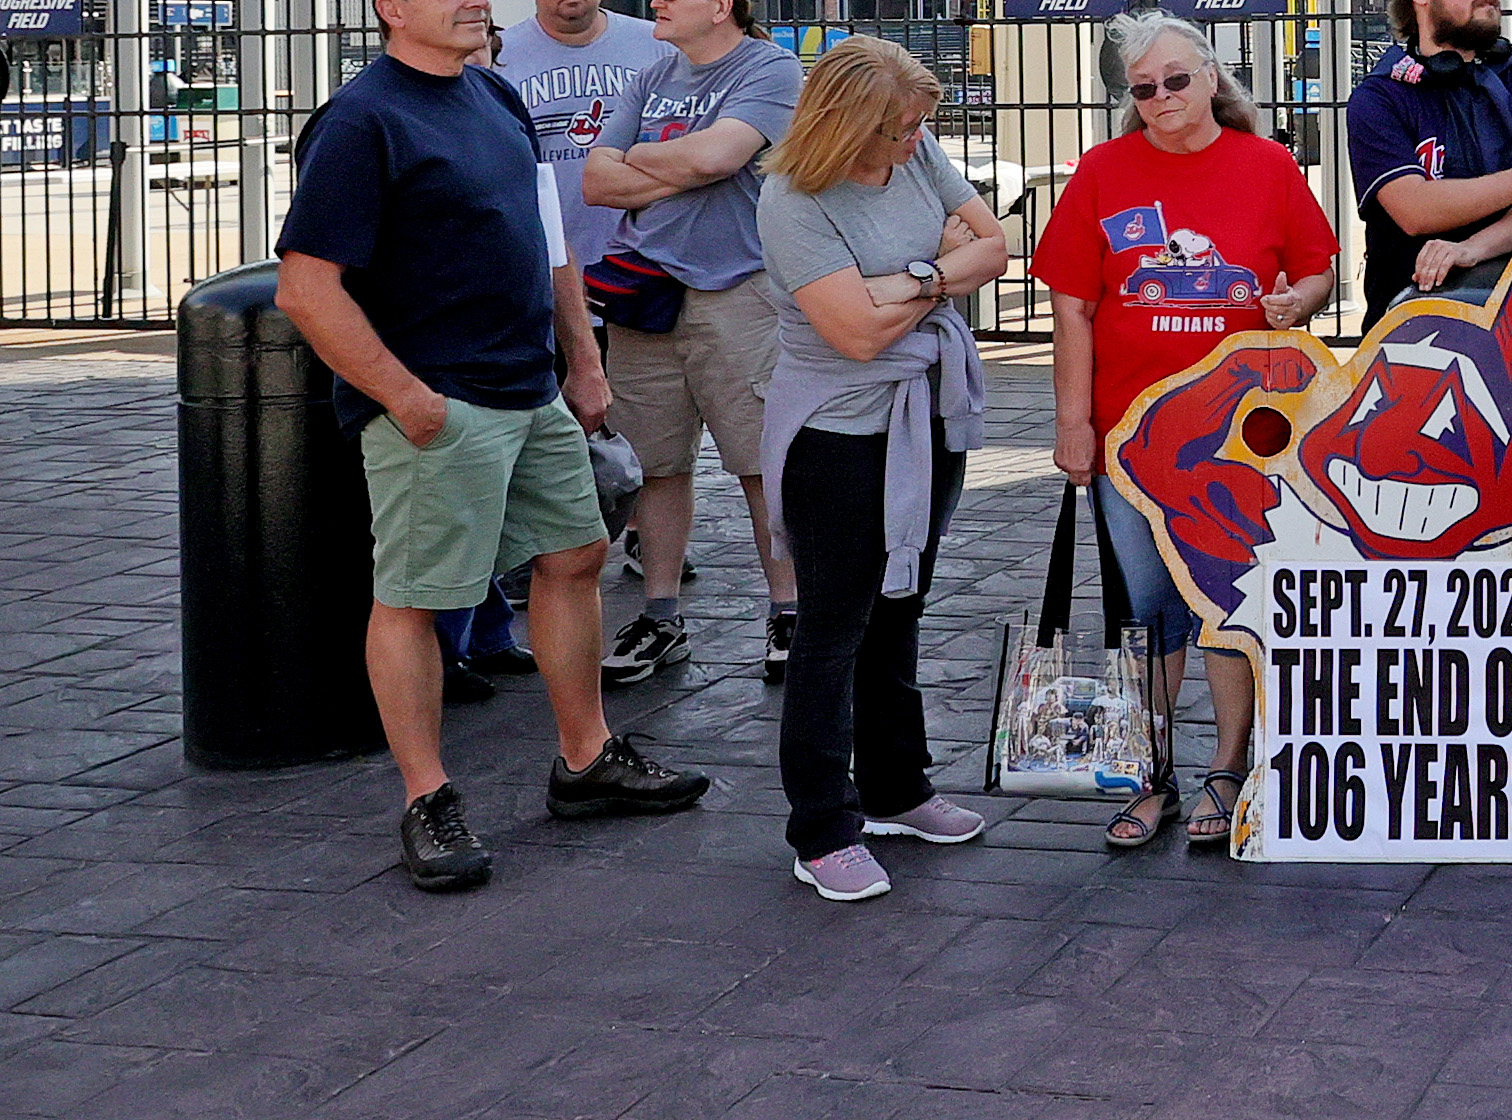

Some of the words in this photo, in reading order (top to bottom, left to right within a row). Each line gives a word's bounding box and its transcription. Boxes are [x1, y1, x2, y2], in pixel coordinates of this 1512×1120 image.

[7, 12, 50, 29] FIELD
[543, 147, 590, 163] LEVELA
[1152, 315, 1226, 333] INDIANS
[1273, 568, 1373, 638] SEPT.
[1383, 569, 1436, 645] 27,
[1271, 648, 1362, 737] THE
[1376, 648, 1470, 737] END
[1270, 741, 1366, 841] 106
